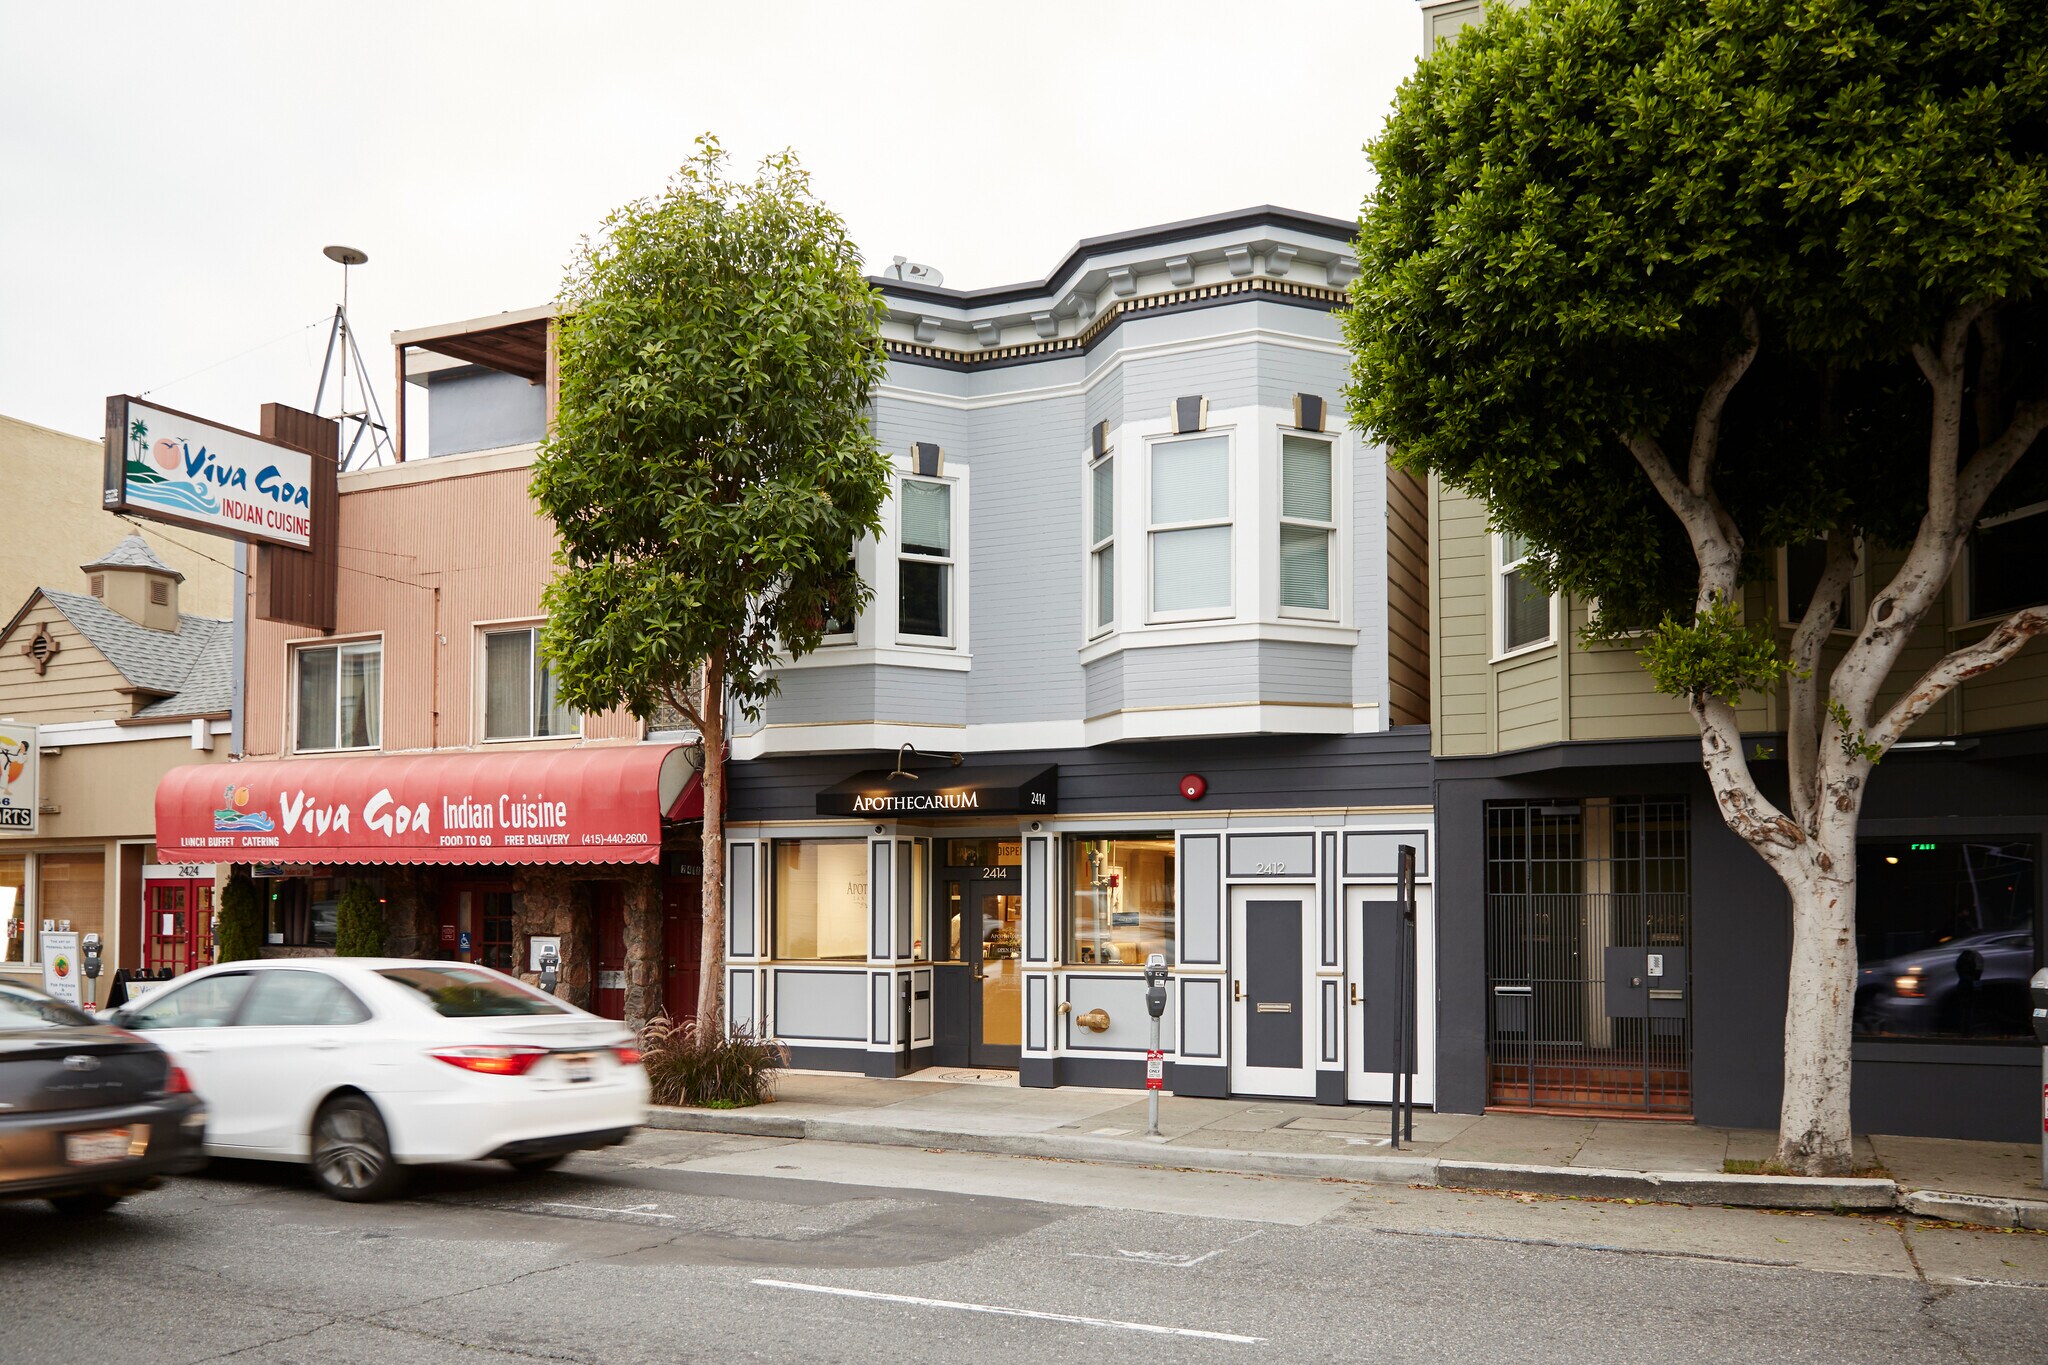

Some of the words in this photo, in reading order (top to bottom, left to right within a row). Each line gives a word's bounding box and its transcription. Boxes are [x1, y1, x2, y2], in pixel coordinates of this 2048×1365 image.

[184, 443, 246, 491] Viva
[255, 465, 309, 509] Goa
[222, 498, 263, 525] INDIAN
[267, 510, 310, 537] CUISINE
[853, 791, 979, 811] APOTHECARIUM
[1031, 792, 1046, 806] 2414
[0, 808, 30, 825] RTS
[280, 789, 350, 837] Viva
[363, 788, 430, 838] Goa
[443, 796, 493, 829] Indian
[499, 794, 567, 828] Cuisine
[181, 837, 206, 847] LUNCH
[208, 837, 235, 847] BUFFET
[242, 836, 279, 847] CATERING
[440, 836, 463, 846] FOOD
[465, 835, 476, 846] TO
[479, 835, 491, 846] GO
[505, 834, 525, 846] FREE
[528, 834, 570, 845] DELIVERY
[582, 833, 648, 845] (415)-440-2600
[998, 846, 1022, 856] DISPE
[179, 866, 199, 877] 2424
[983, 867, 1007, 879] 2414
[1256, 862, 1285, 875] 2412
